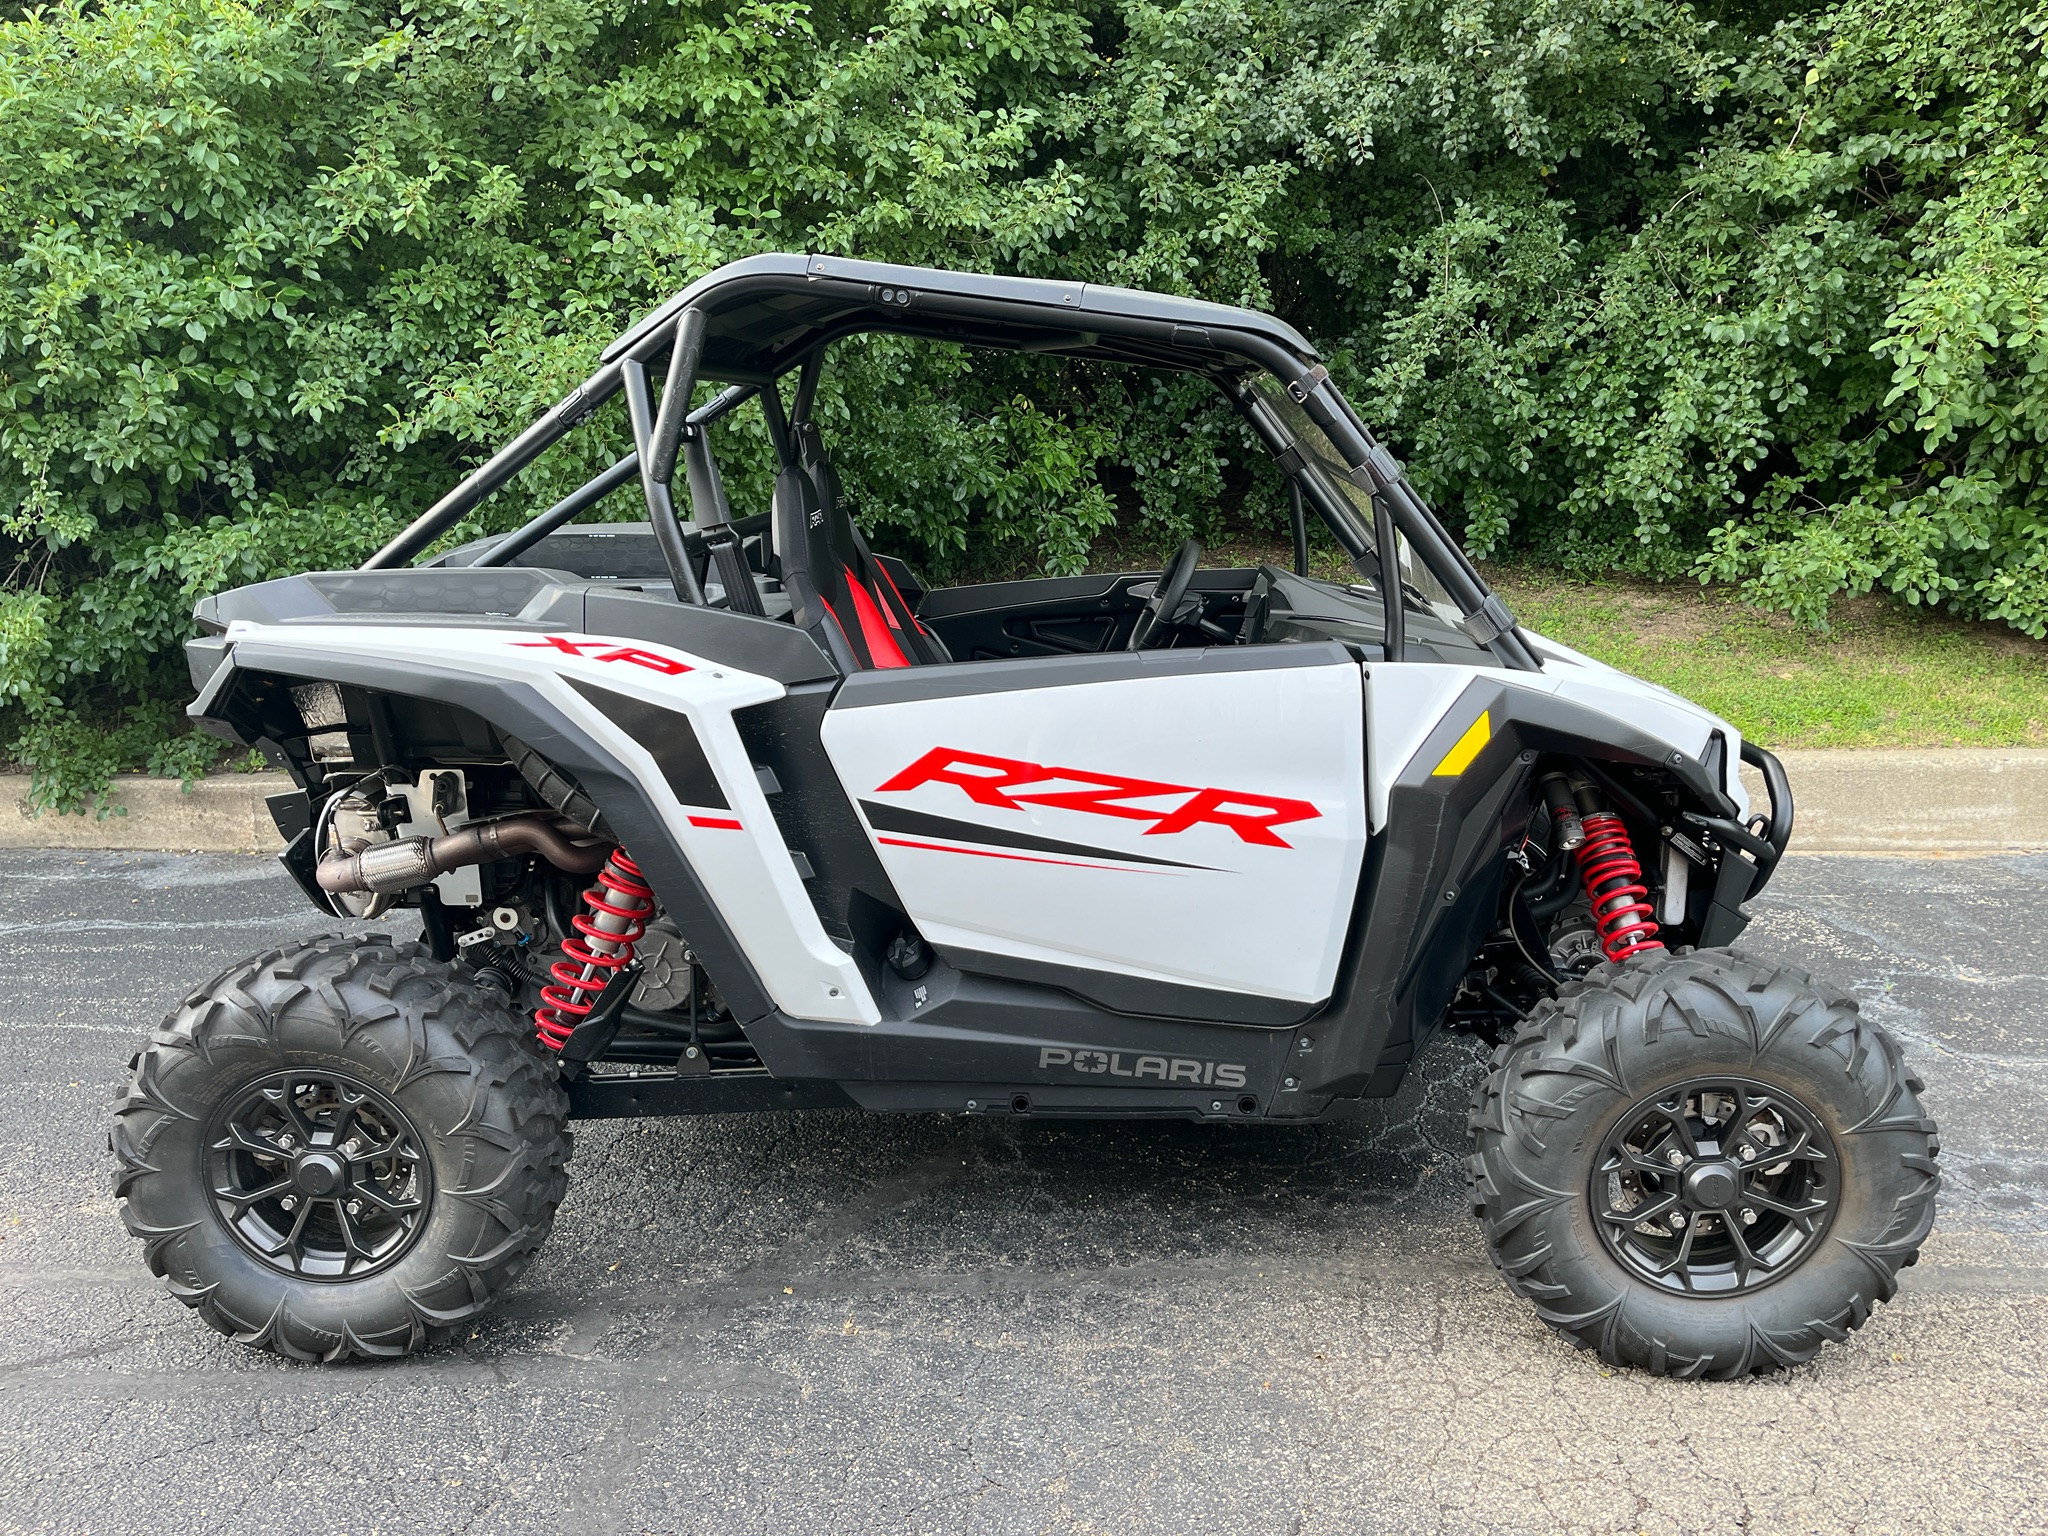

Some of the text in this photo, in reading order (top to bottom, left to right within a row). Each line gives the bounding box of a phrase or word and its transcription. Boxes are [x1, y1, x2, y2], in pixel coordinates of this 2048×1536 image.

[505, 636, 695, 676] XP
[873, 746, 1323, 849] RZR
[1039, 1047, 1247, 1088] POLARIS
